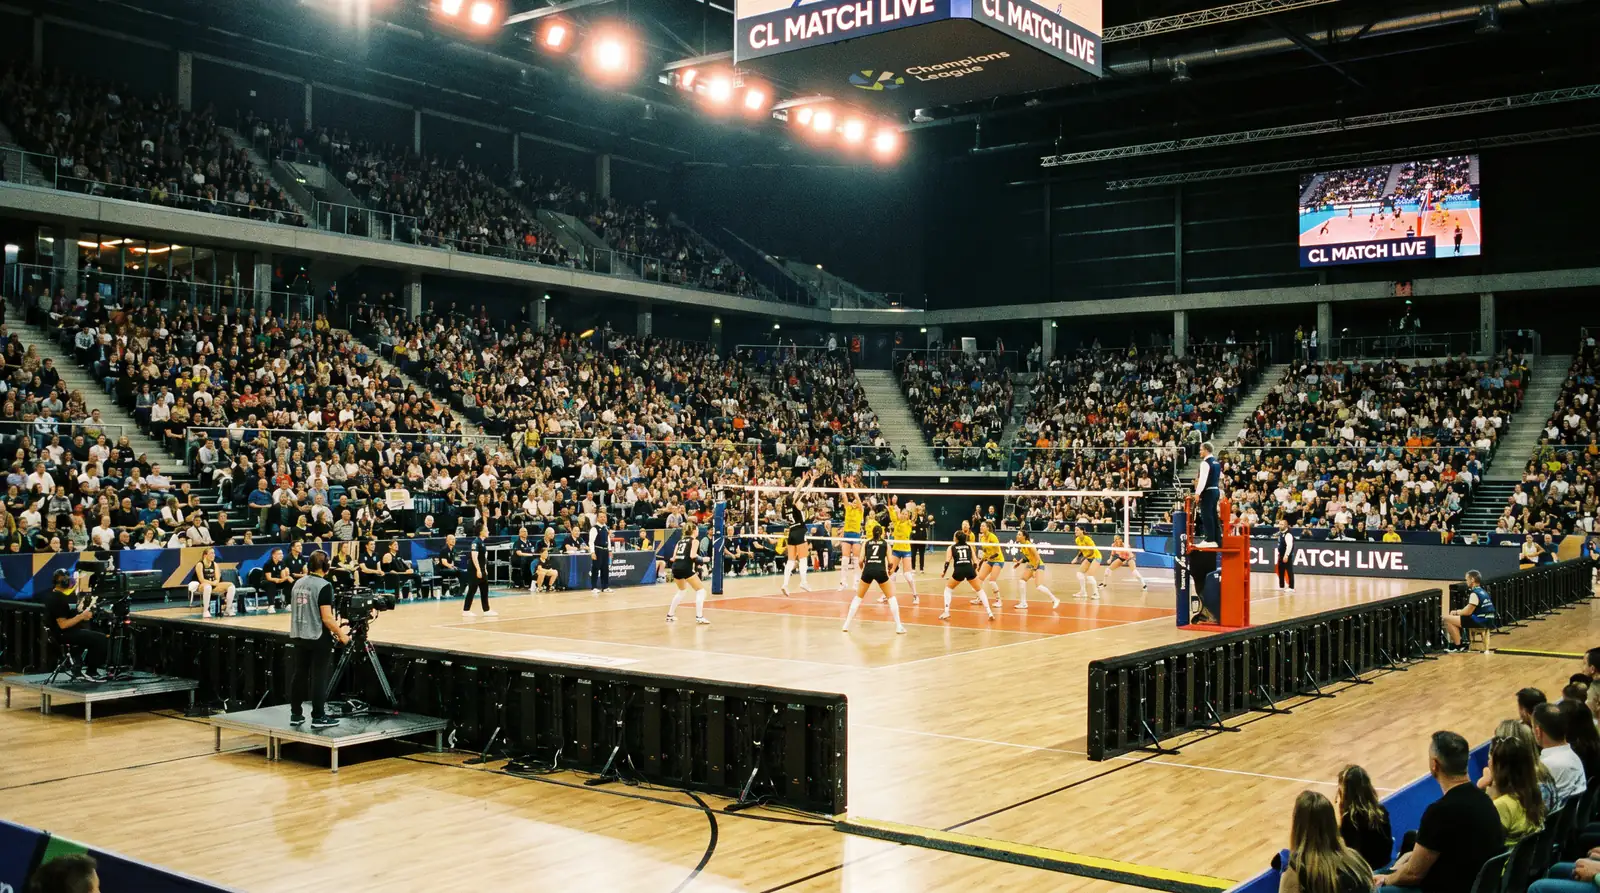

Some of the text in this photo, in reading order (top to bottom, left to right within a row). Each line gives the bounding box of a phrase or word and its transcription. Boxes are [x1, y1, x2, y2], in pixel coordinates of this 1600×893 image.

[749, 0, 935, 49] CL MATCH LIVE
[981, 0, 1095, 65] CL MATCH LIVE
[905, 51, 1011, 75] Champions
[915, 65, 984, 82] League
[1308, 240, 1426, 263] CL MATCH LIVE
[871, 544, 880, 556] 7
[1274, 547, 1350, 568] ATCH
[1356, 550, 1409, 571] LIVE.
